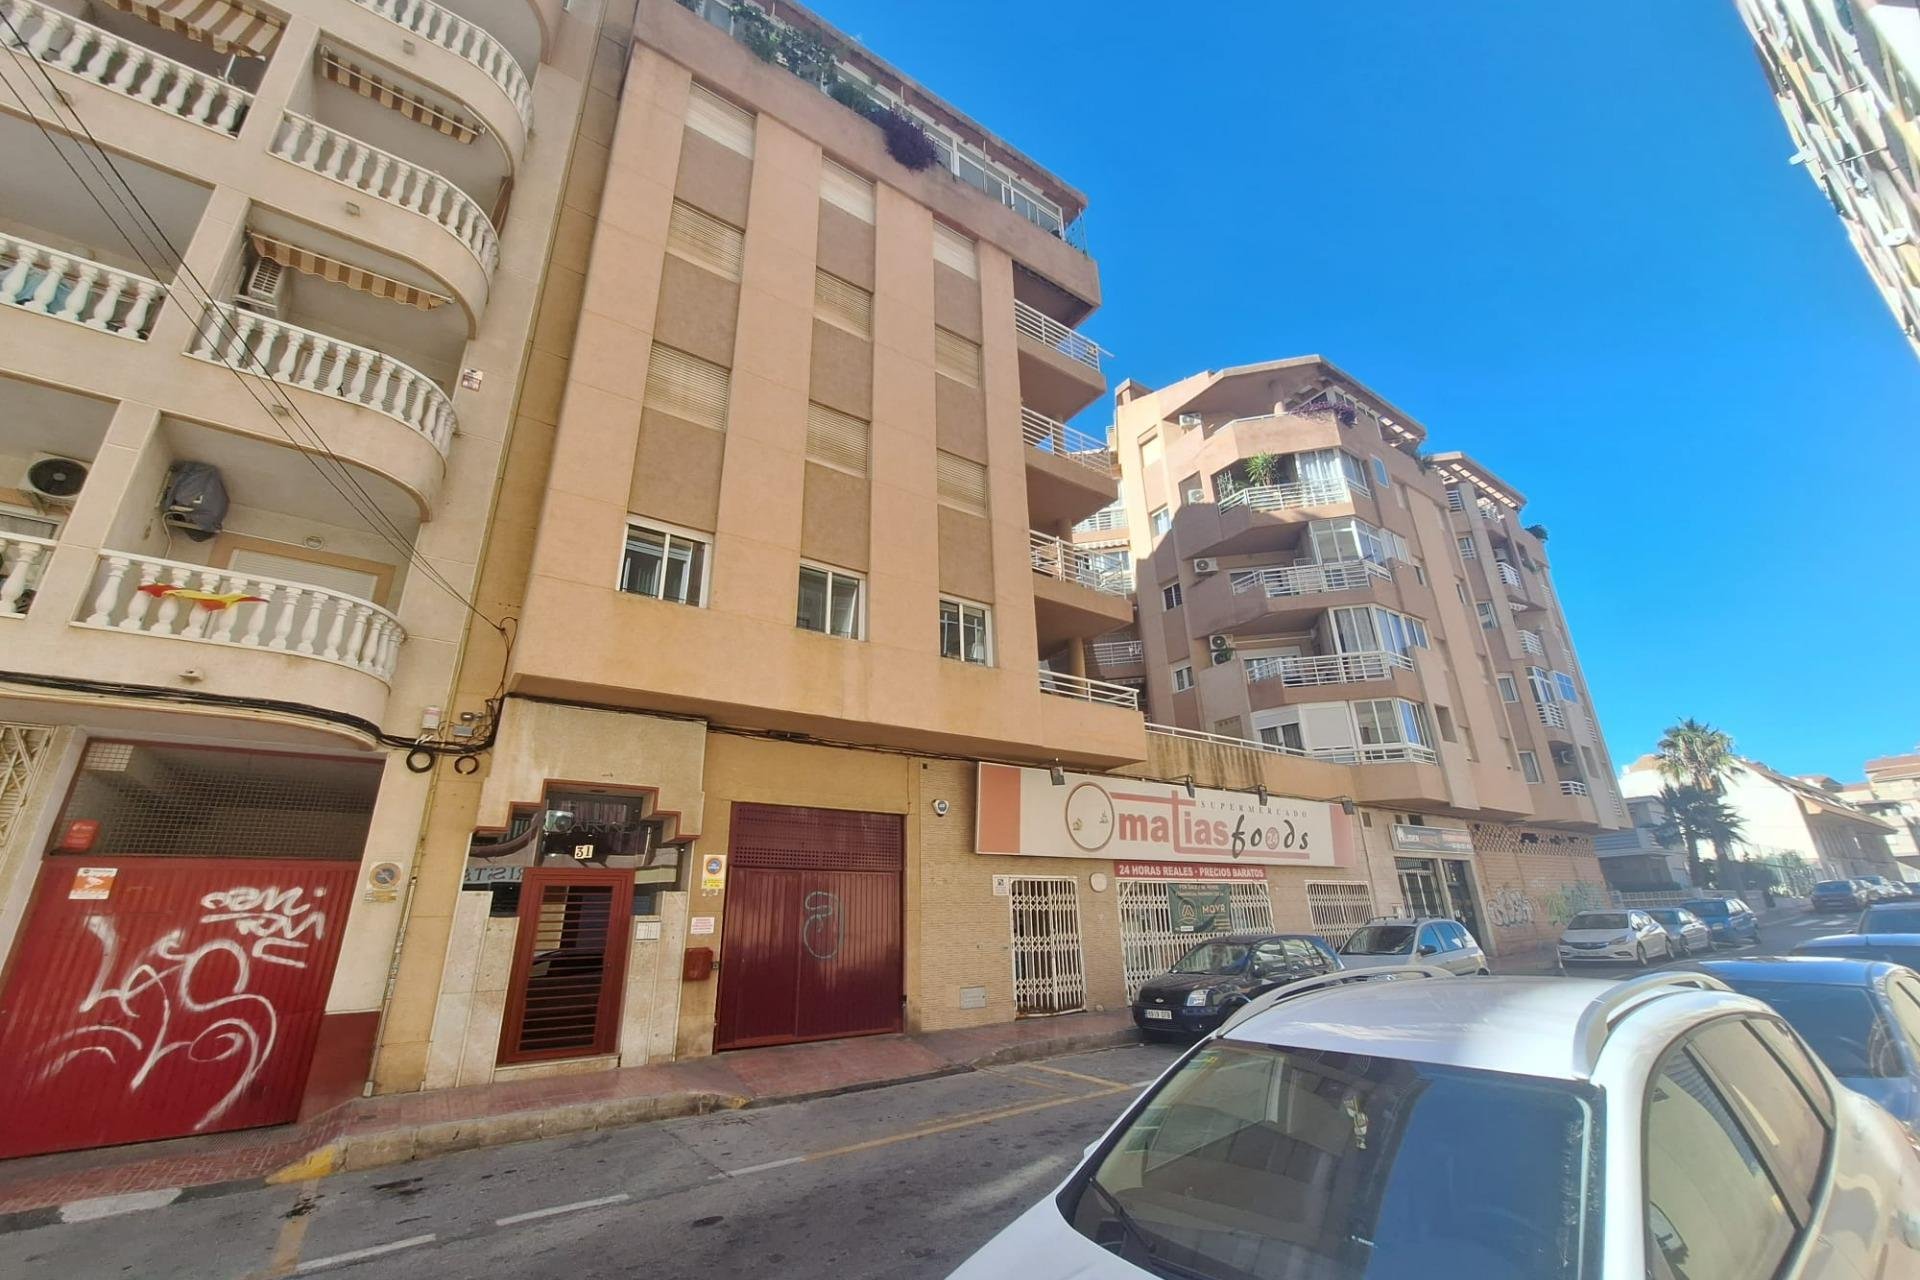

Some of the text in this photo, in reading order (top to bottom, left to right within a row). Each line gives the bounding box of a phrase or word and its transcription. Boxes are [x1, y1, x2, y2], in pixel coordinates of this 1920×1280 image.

[1200, 800, 1309, 818] SUPERMERCADO
[1118, 790, 1230, 856] matias
[575, 845, 592, 858] 31
[1119, 865, 1265, 878] 24 HORAS REALES PRECIOS BARATOS
